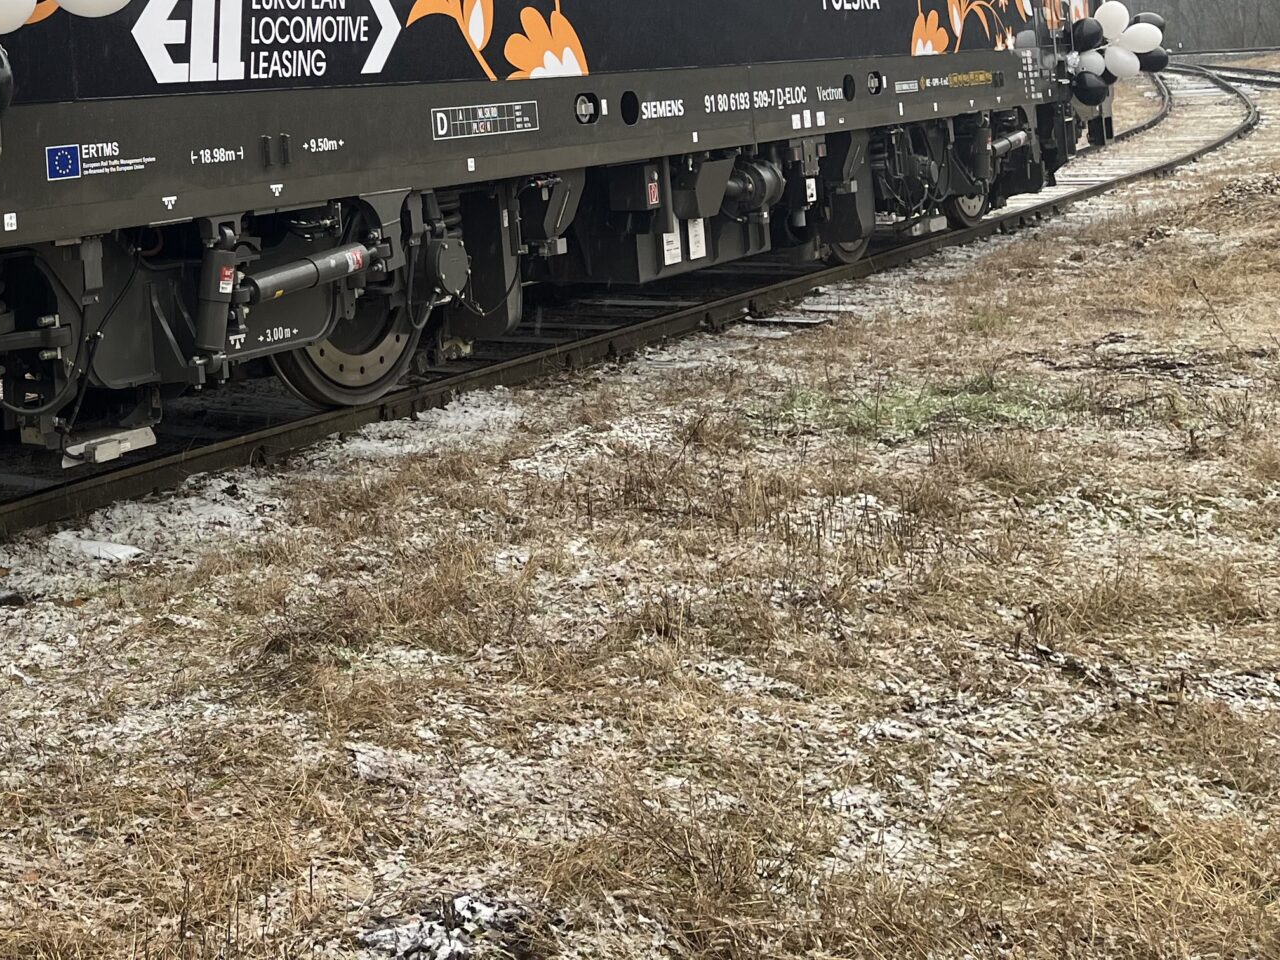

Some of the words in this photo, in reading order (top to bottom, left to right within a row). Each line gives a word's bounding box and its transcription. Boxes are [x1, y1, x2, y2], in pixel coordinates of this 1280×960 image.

[250, 15, 369, 44] LOCOMOTIVE
[250, 49, 327, 80] LEASING
[704, 94, 716, 113] 91
[717, 93, 728, 112] 80
[729, 92, 750, 111] 6193
[753, 90, 776, 109] 509-7
[777, 86, 807, 109] D-ELOC
[816, 85, 844, 102] Vectron
[641, 99, 685, 119] SIEMENS
[436, 112, 448, 136] D
[81, 141, 120, 158] ERTMS
[310, 138, 337, 152] 9.50m
[199, 147, 236, 164] 18.98m
